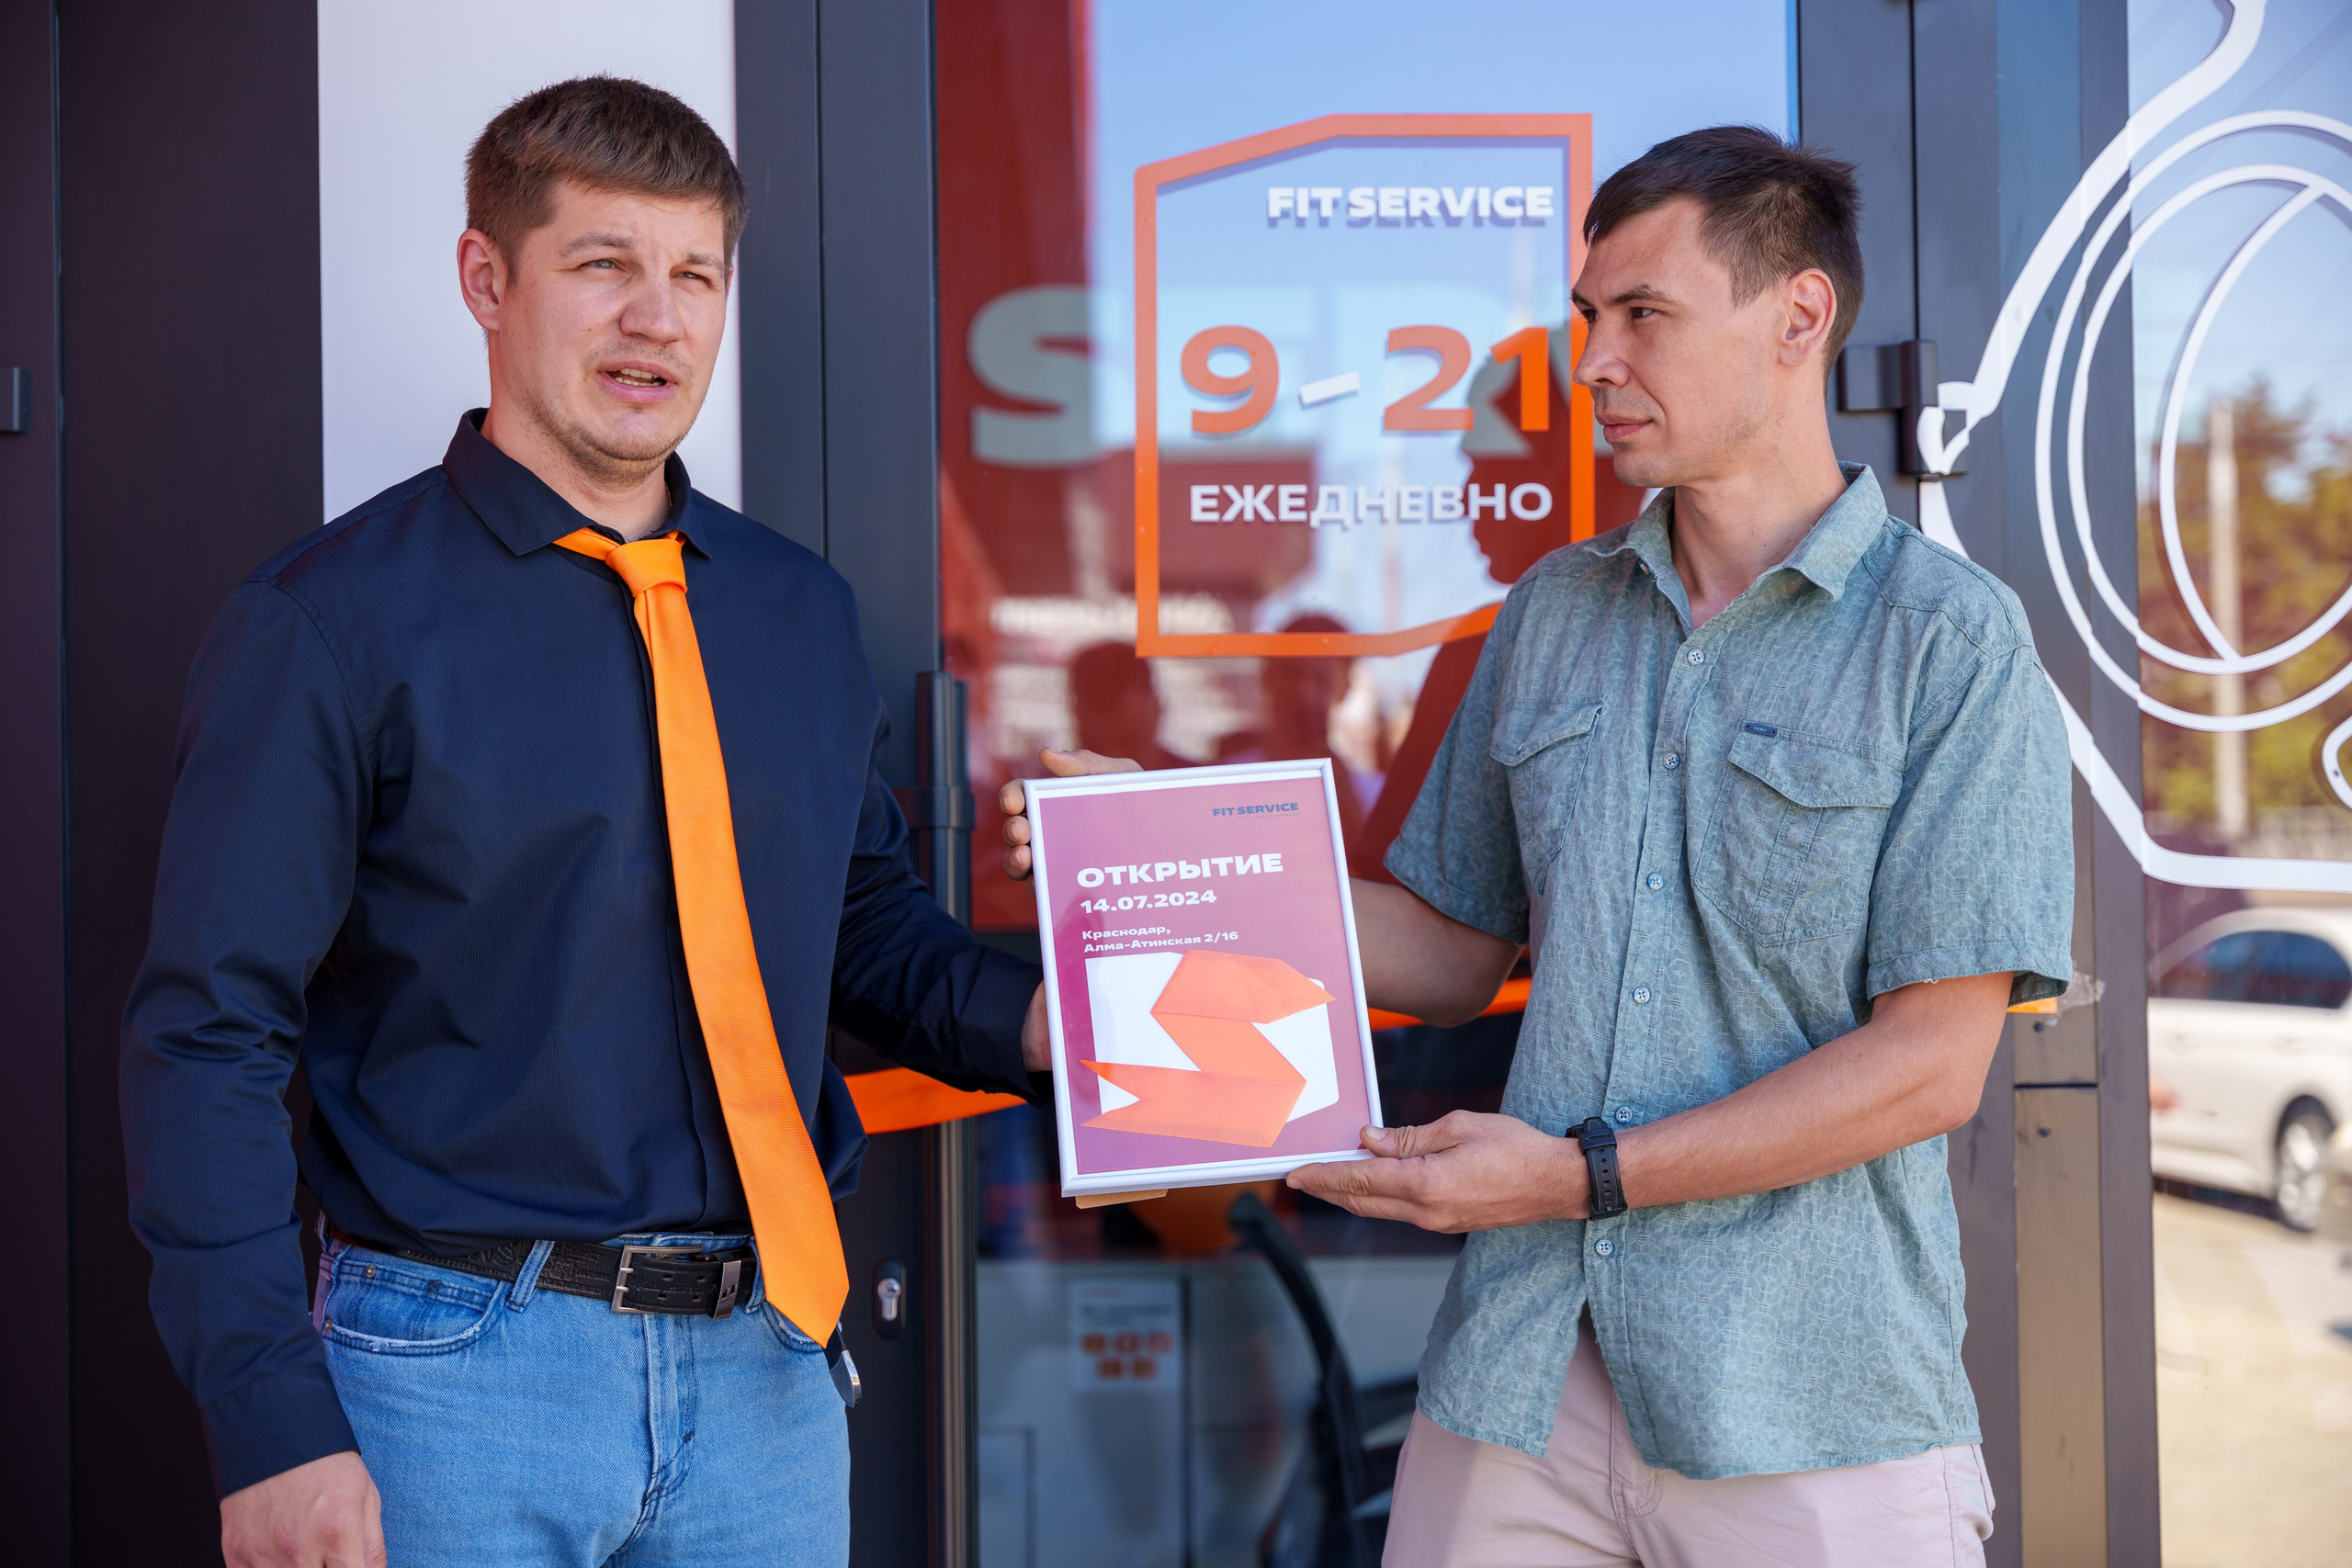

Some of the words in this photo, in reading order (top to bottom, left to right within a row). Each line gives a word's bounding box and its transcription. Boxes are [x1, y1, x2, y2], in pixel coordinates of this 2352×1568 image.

[1268, 186, 1343, 219] FIT
[1347, 186, 1554, 219] SERVICE
[1181, 325, 1281, 434] 9
[1383, 324, 1551, 433] 21
[1190, 482, 1554, 529] ЕЖЕДНЕВНО
[1213, 807, 1235, 817] FIT
[1237, 802, 1299, 815] SERVICE
[1077, 852, 1283, 888] ОТКРЫТИЕ
[1080, 889, 1217, 914] 14.07.2024
[1081, 926, 1171, 941] Краснодар,
[1083, 936, 1202, 953] Алма-Атинская
[1204, 931, 1239, 943] 2/16
